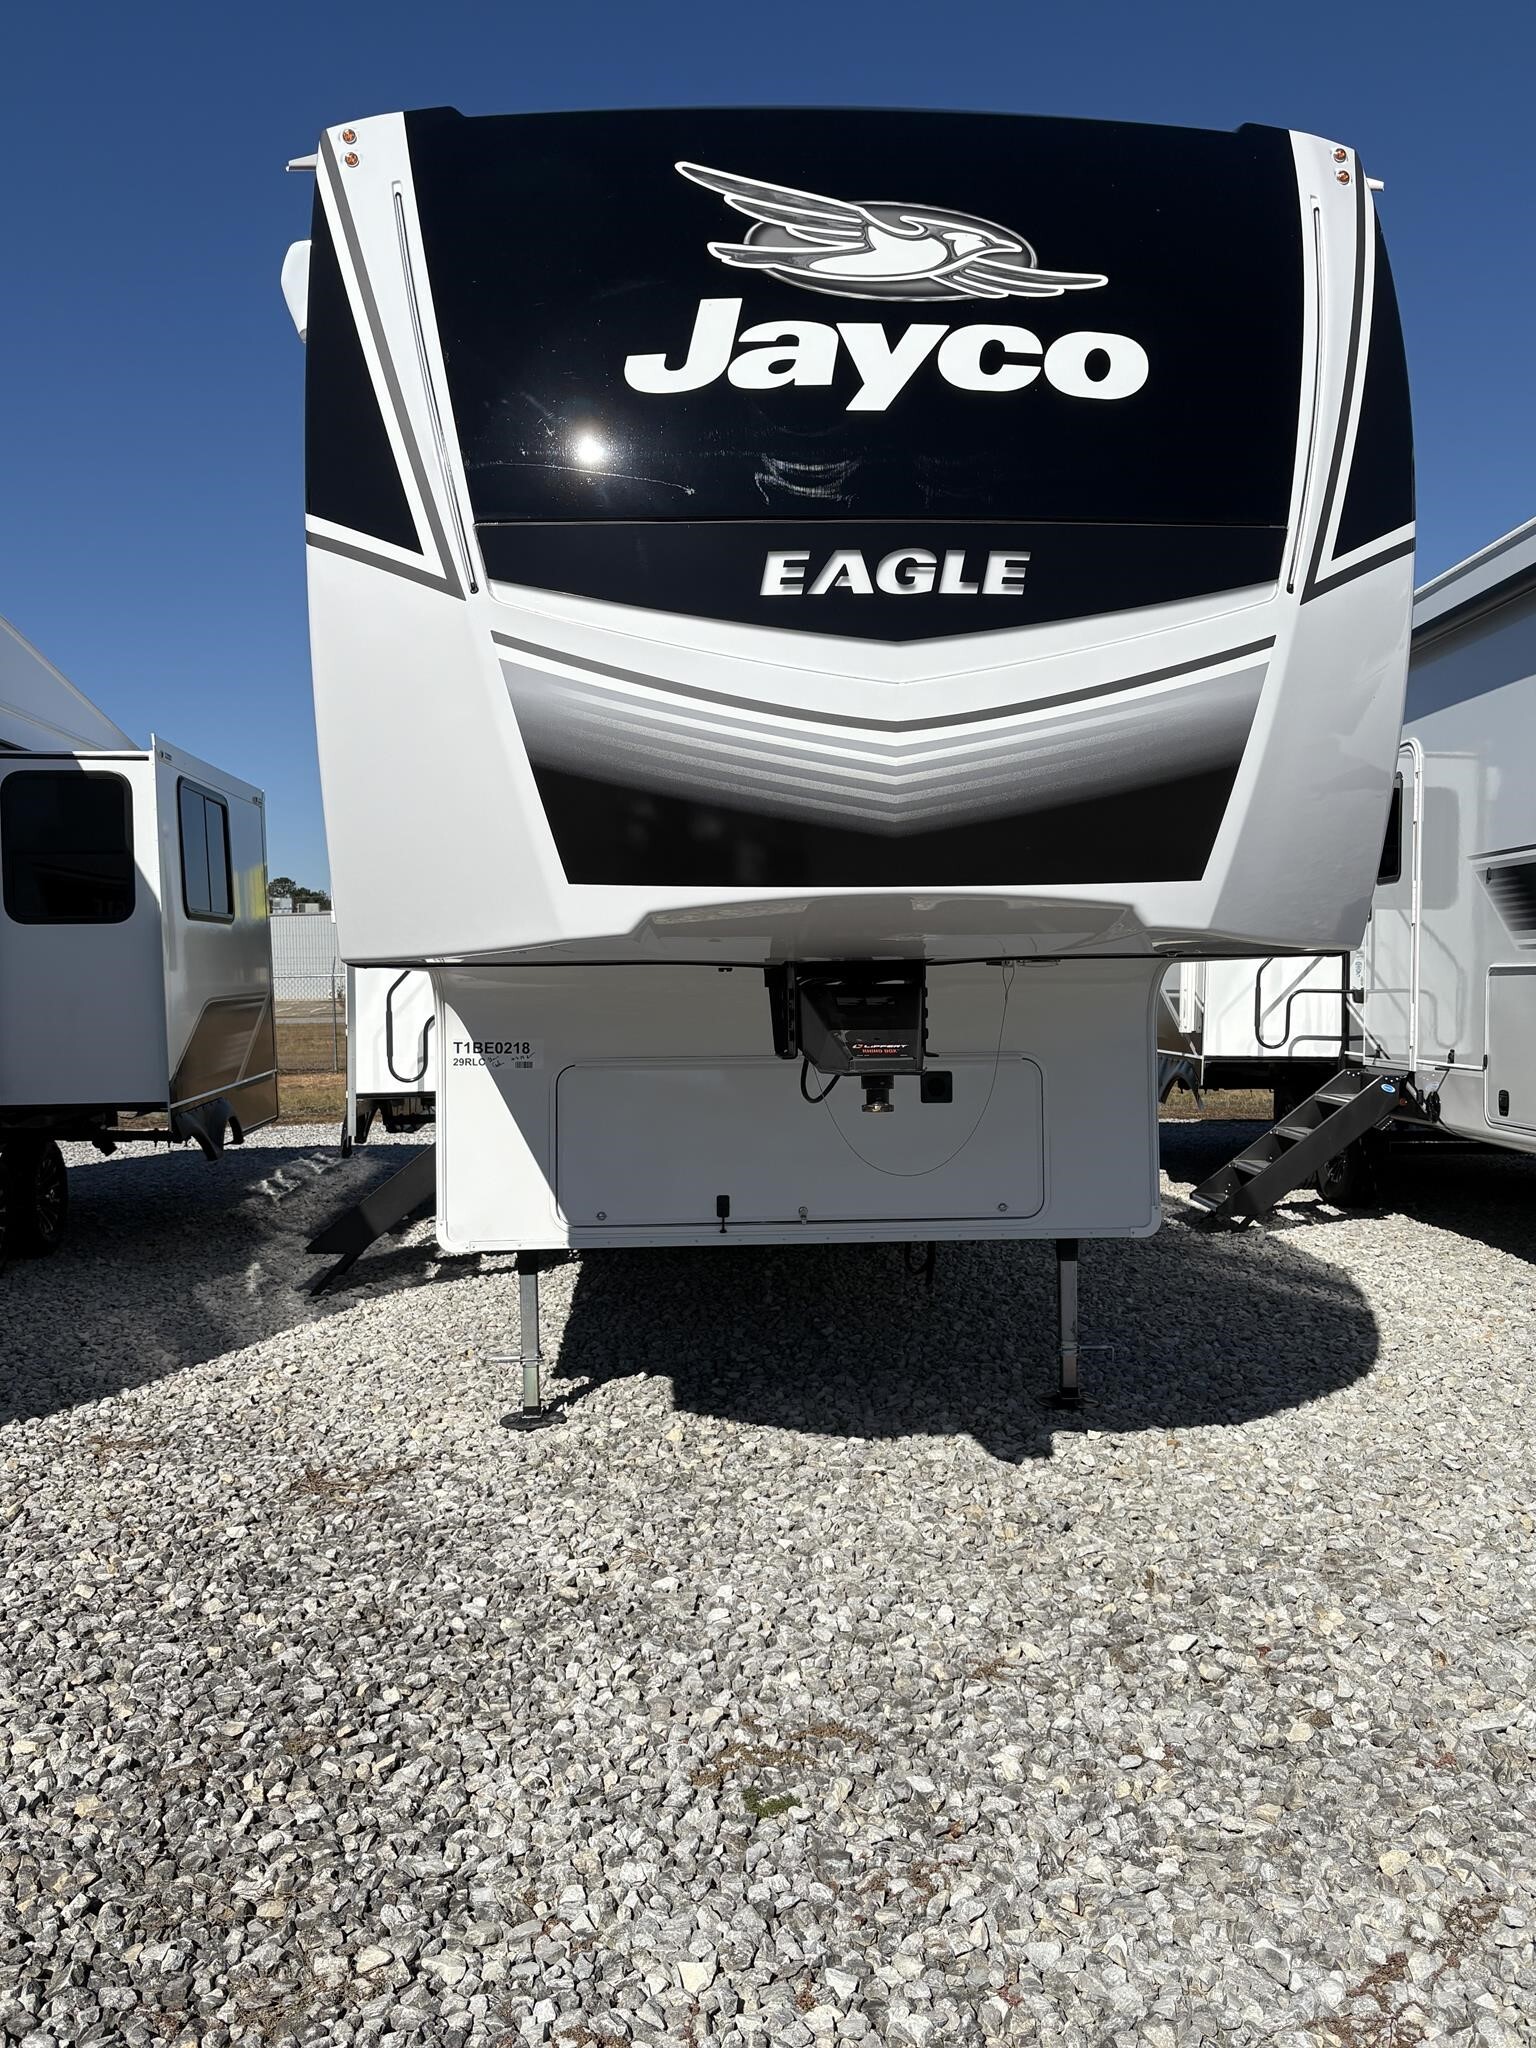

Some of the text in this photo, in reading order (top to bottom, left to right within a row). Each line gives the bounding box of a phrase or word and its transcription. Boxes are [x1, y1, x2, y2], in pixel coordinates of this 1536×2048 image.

[624, 298, 1149, 411] Jayco
[759, 547, 1031, 596] EAGLE
[453, 1041, 530, 1054] T1BE0218
